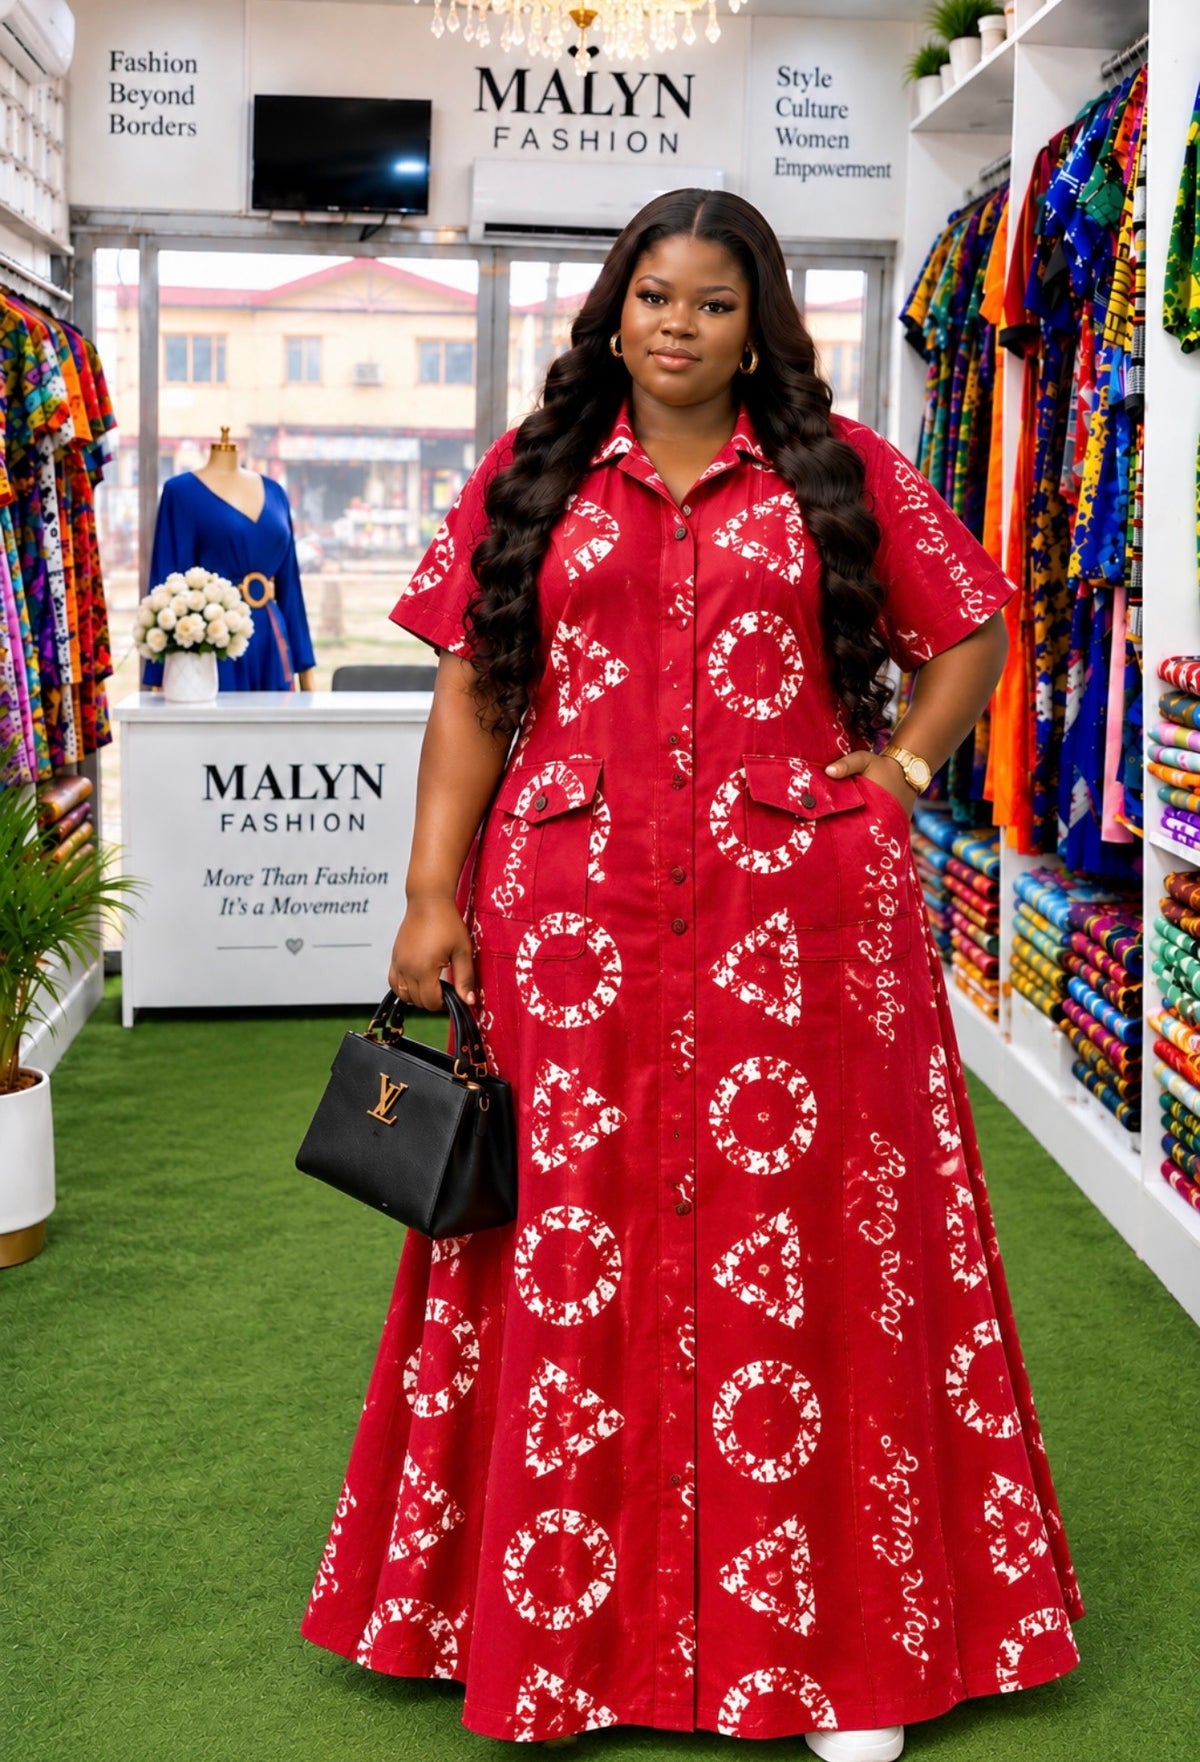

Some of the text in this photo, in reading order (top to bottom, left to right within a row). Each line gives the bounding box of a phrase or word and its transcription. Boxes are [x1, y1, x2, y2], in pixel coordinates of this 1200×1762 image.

[109, 50, 198, 74] Fashion
[776, 65, 833, 93] Style
[109, 82, 195, 110] Beyond
[473, 67, 696, 120] MALYN
[775, 97, 849, 120] Culture
[109, 113, 197, 137] Borders
[493, 126, 679, 155] FASHION
[775, 126, 850, 150] Women
[774, 157, 892, 183] Empowerment
[203, 763, 386, 801] MALYN
[220, 813, 365, 833] FASHION
[203, 866, 389, 887] More Than Fashion
[219, 897, 370, 916] It's a Movement
